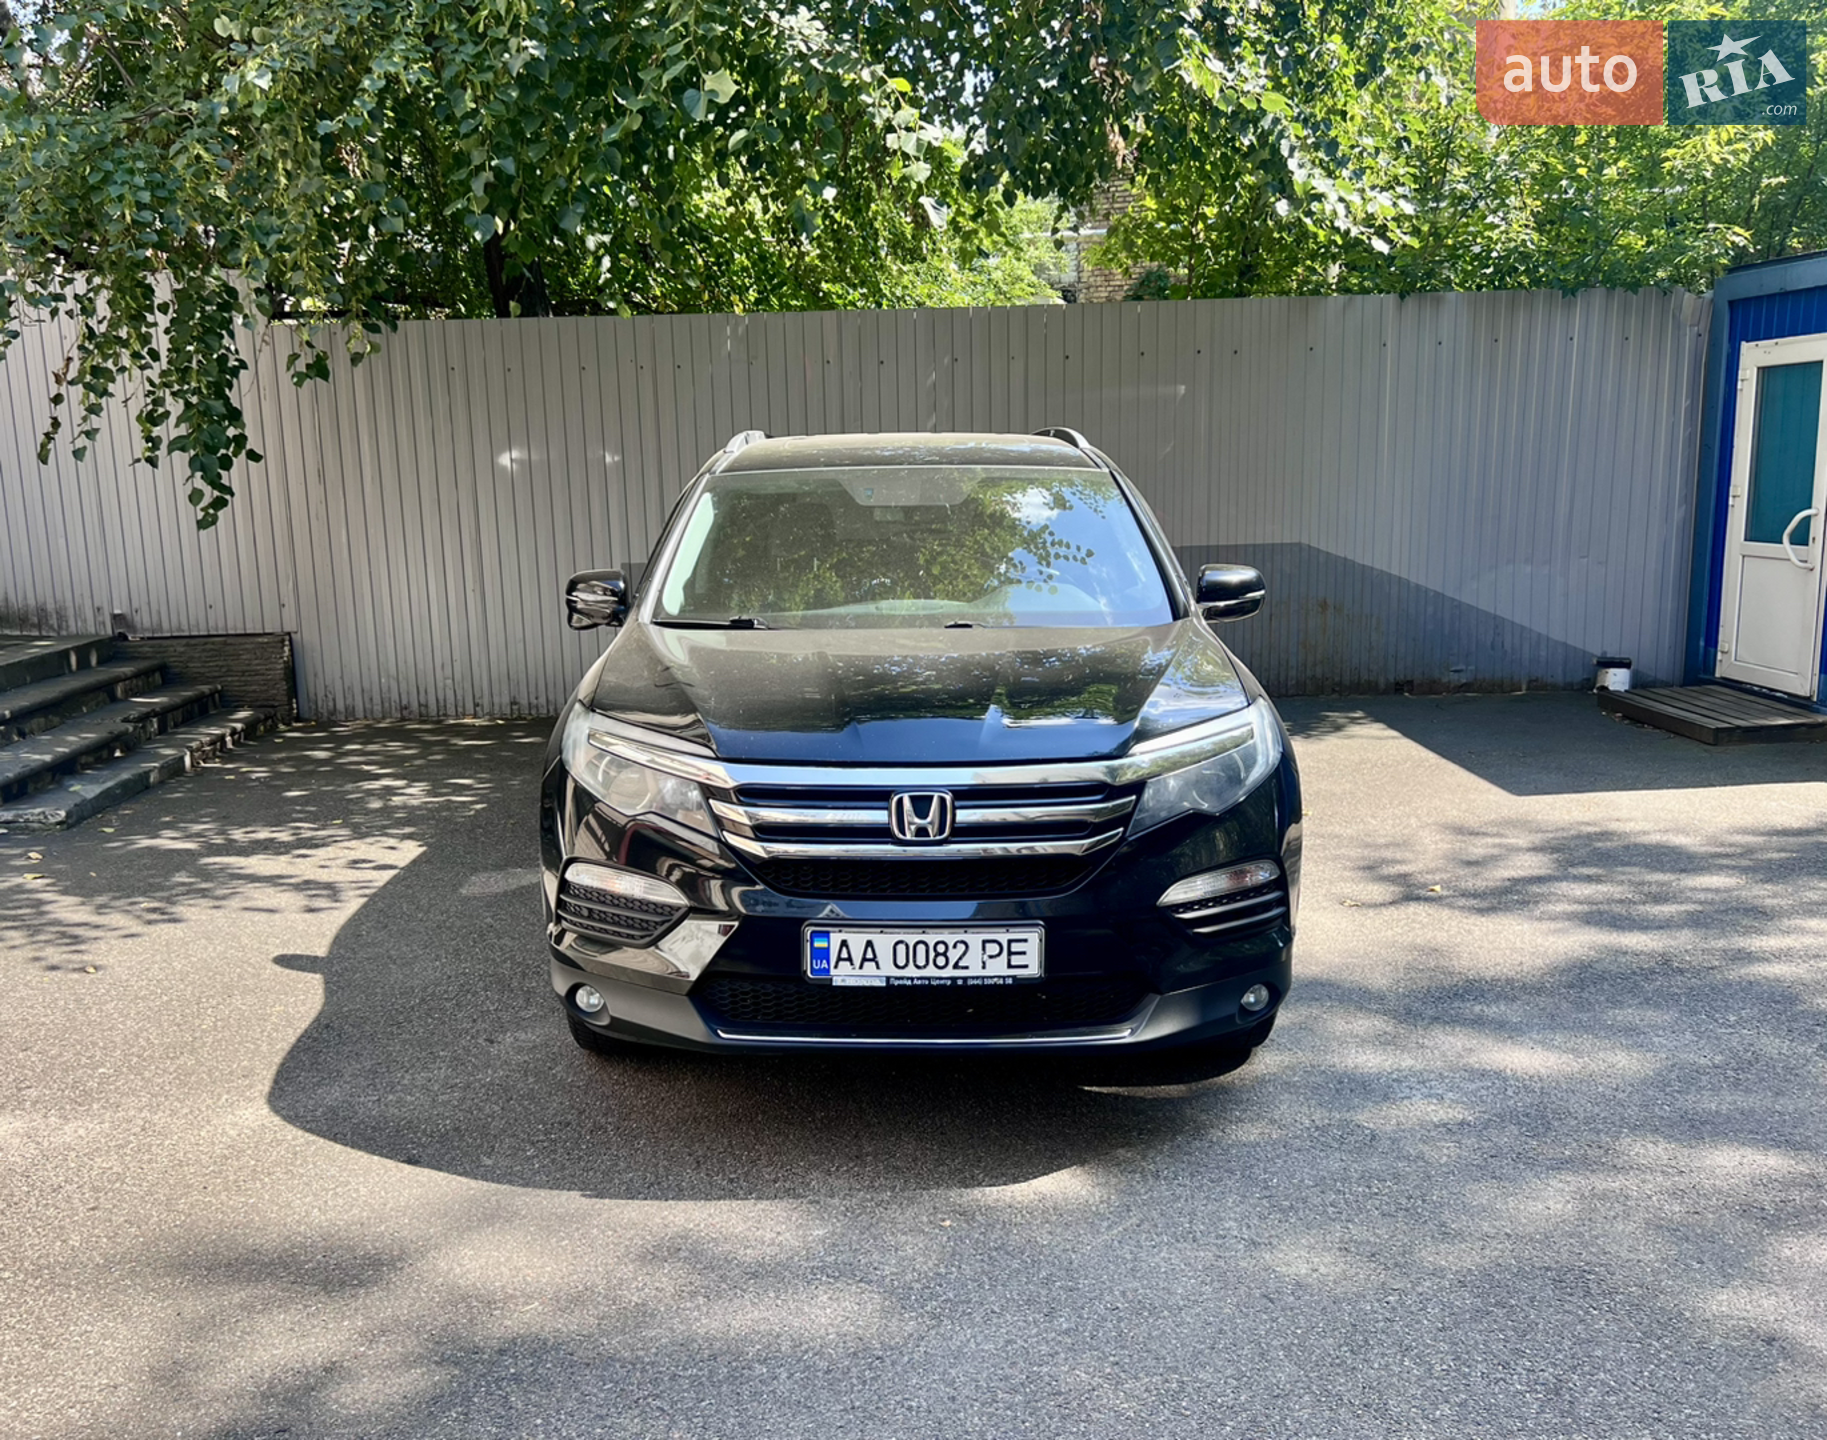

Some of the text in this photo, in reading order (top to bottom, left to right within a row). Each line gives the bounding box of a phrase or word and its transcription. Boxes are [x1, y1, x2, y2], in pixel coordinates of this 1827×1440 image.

[833, 938, 1029, 970] AA 0082 PE
[812, 959, 829, 970] UA
[930, 977, 952, 986] Центр
